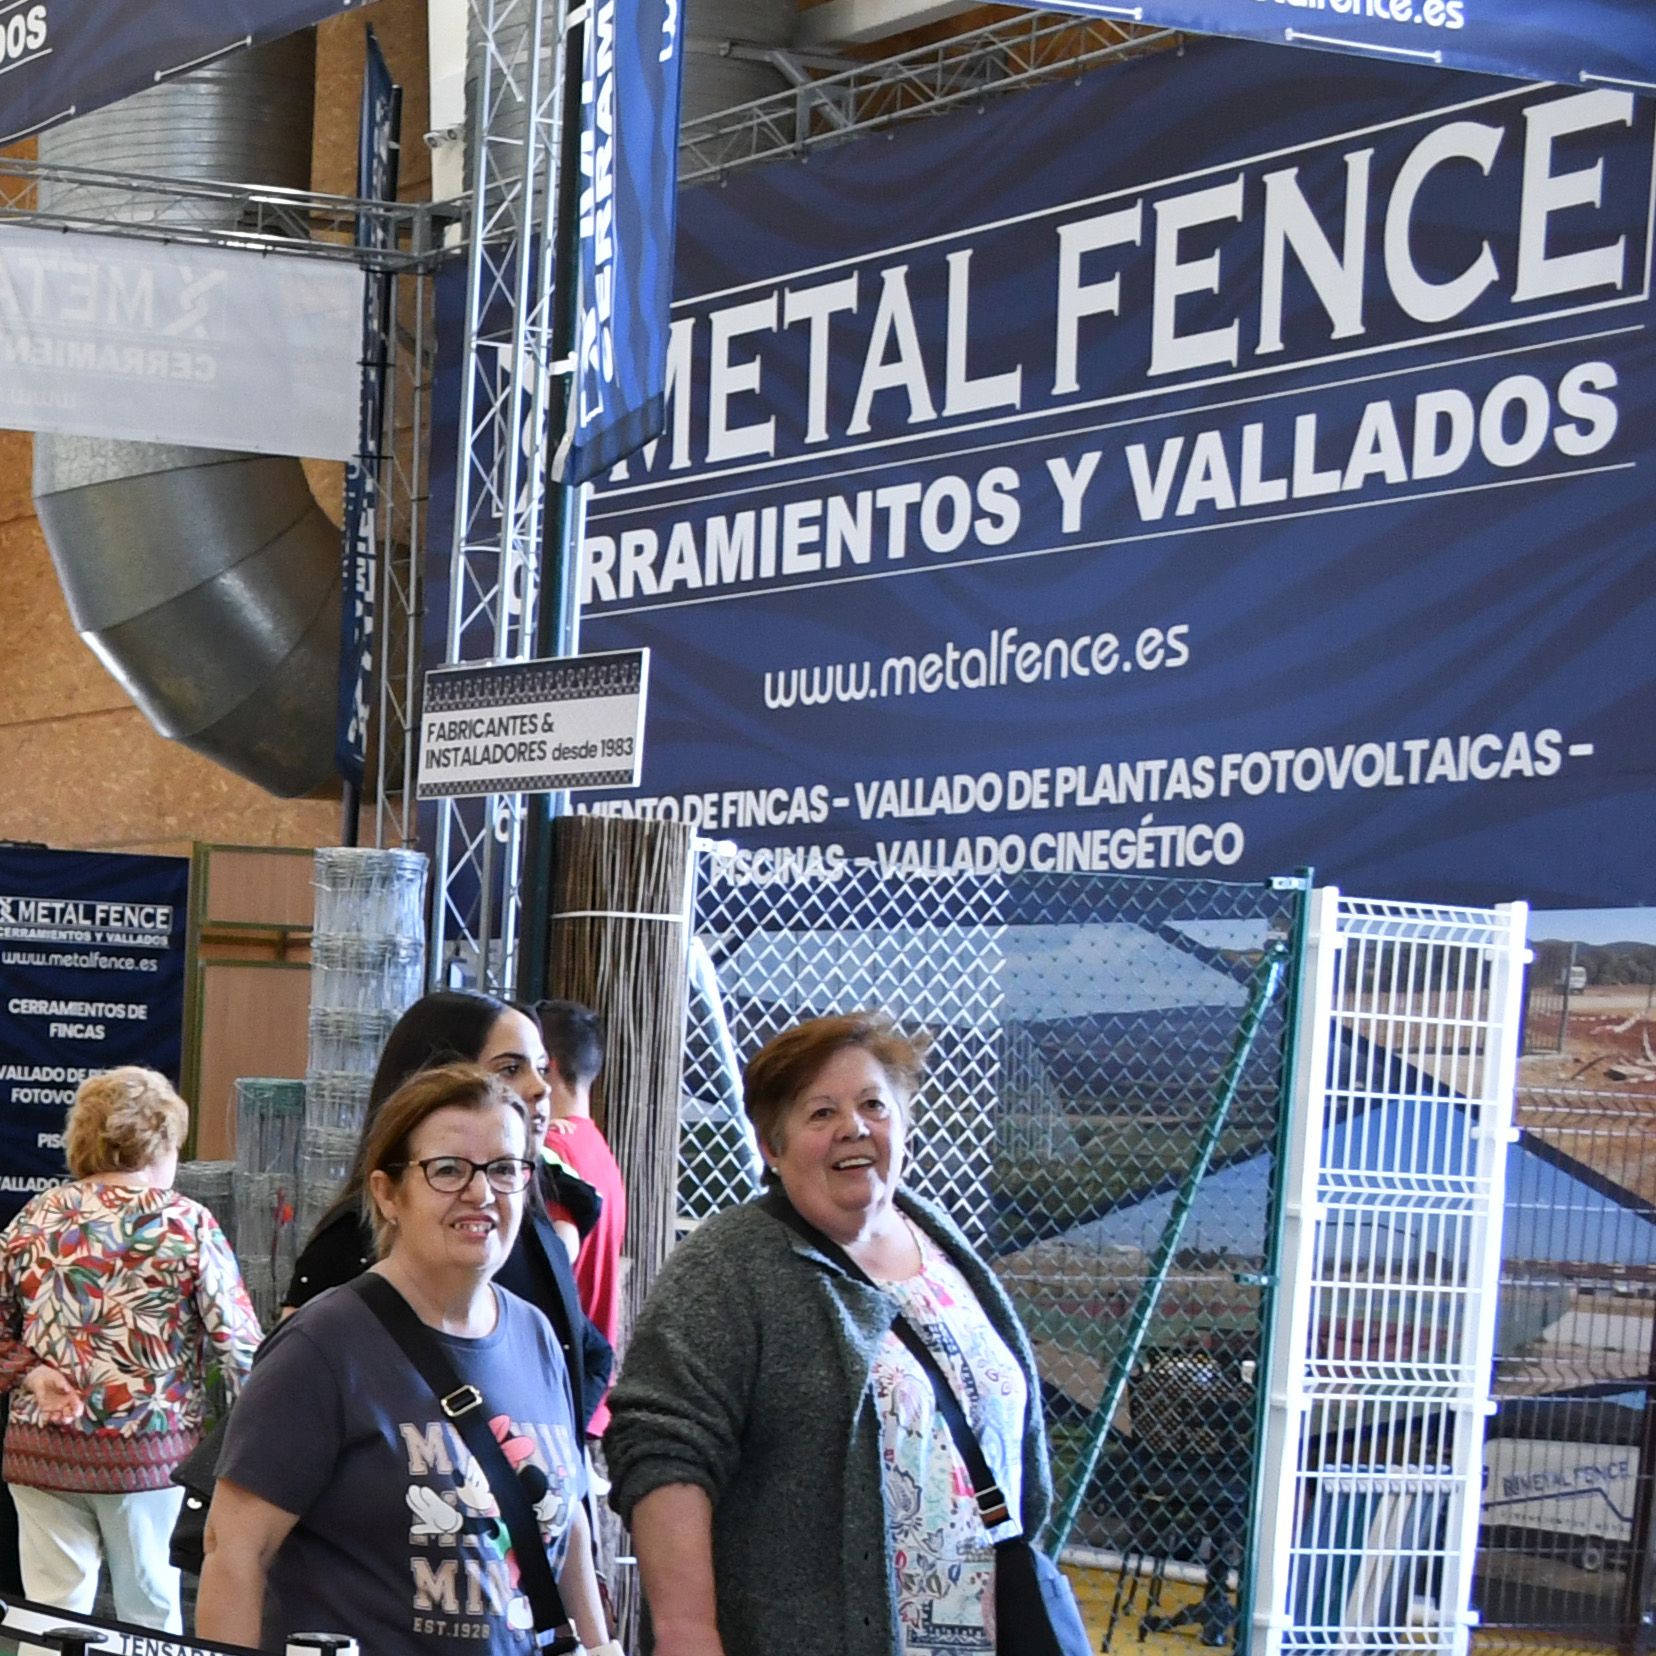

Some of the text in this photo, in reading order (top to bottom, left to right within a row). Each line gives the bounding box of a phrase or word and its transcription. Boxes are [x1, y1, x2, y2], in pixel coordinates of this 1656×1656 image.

[1051, 88, 1634, 397] FENCE
[1046, 451, 1102, 533] Y
[1125, 361, 1619, 521] VALLADOS
[764, 623, 1189, 709] www.metalfence.es
[426, 712, 555, 743] FABRICANTES &
[425, 736, 634, 769] INSTALADORES desde 1983
[683, 793, 719, 829] DE
[722, 785, 830, 829] FINCAS
[854, 773, 1004, 820] VALLADO
[1008, 769, 1050, 812] DE
[1054, 756, 1215, 809] PLANTAS
[1220, 729, 1563, 797] FOTOVOLTAICAS
[876, 835, 1026, 881] VALLADO
[1030, 812, 1245, 872] CINEGÉTICO
[18, 900, 170, 929] METAL FENCE
[94, 931, 104, 942] Y
[105, 932, 169, 946] VALLADOS
[1, 951, 158, 972] www.metalfence.es
[8, 998, 148, 1020] CERRAMIENTOS DE
[49, 1022, 106, 1040] FINCAS
